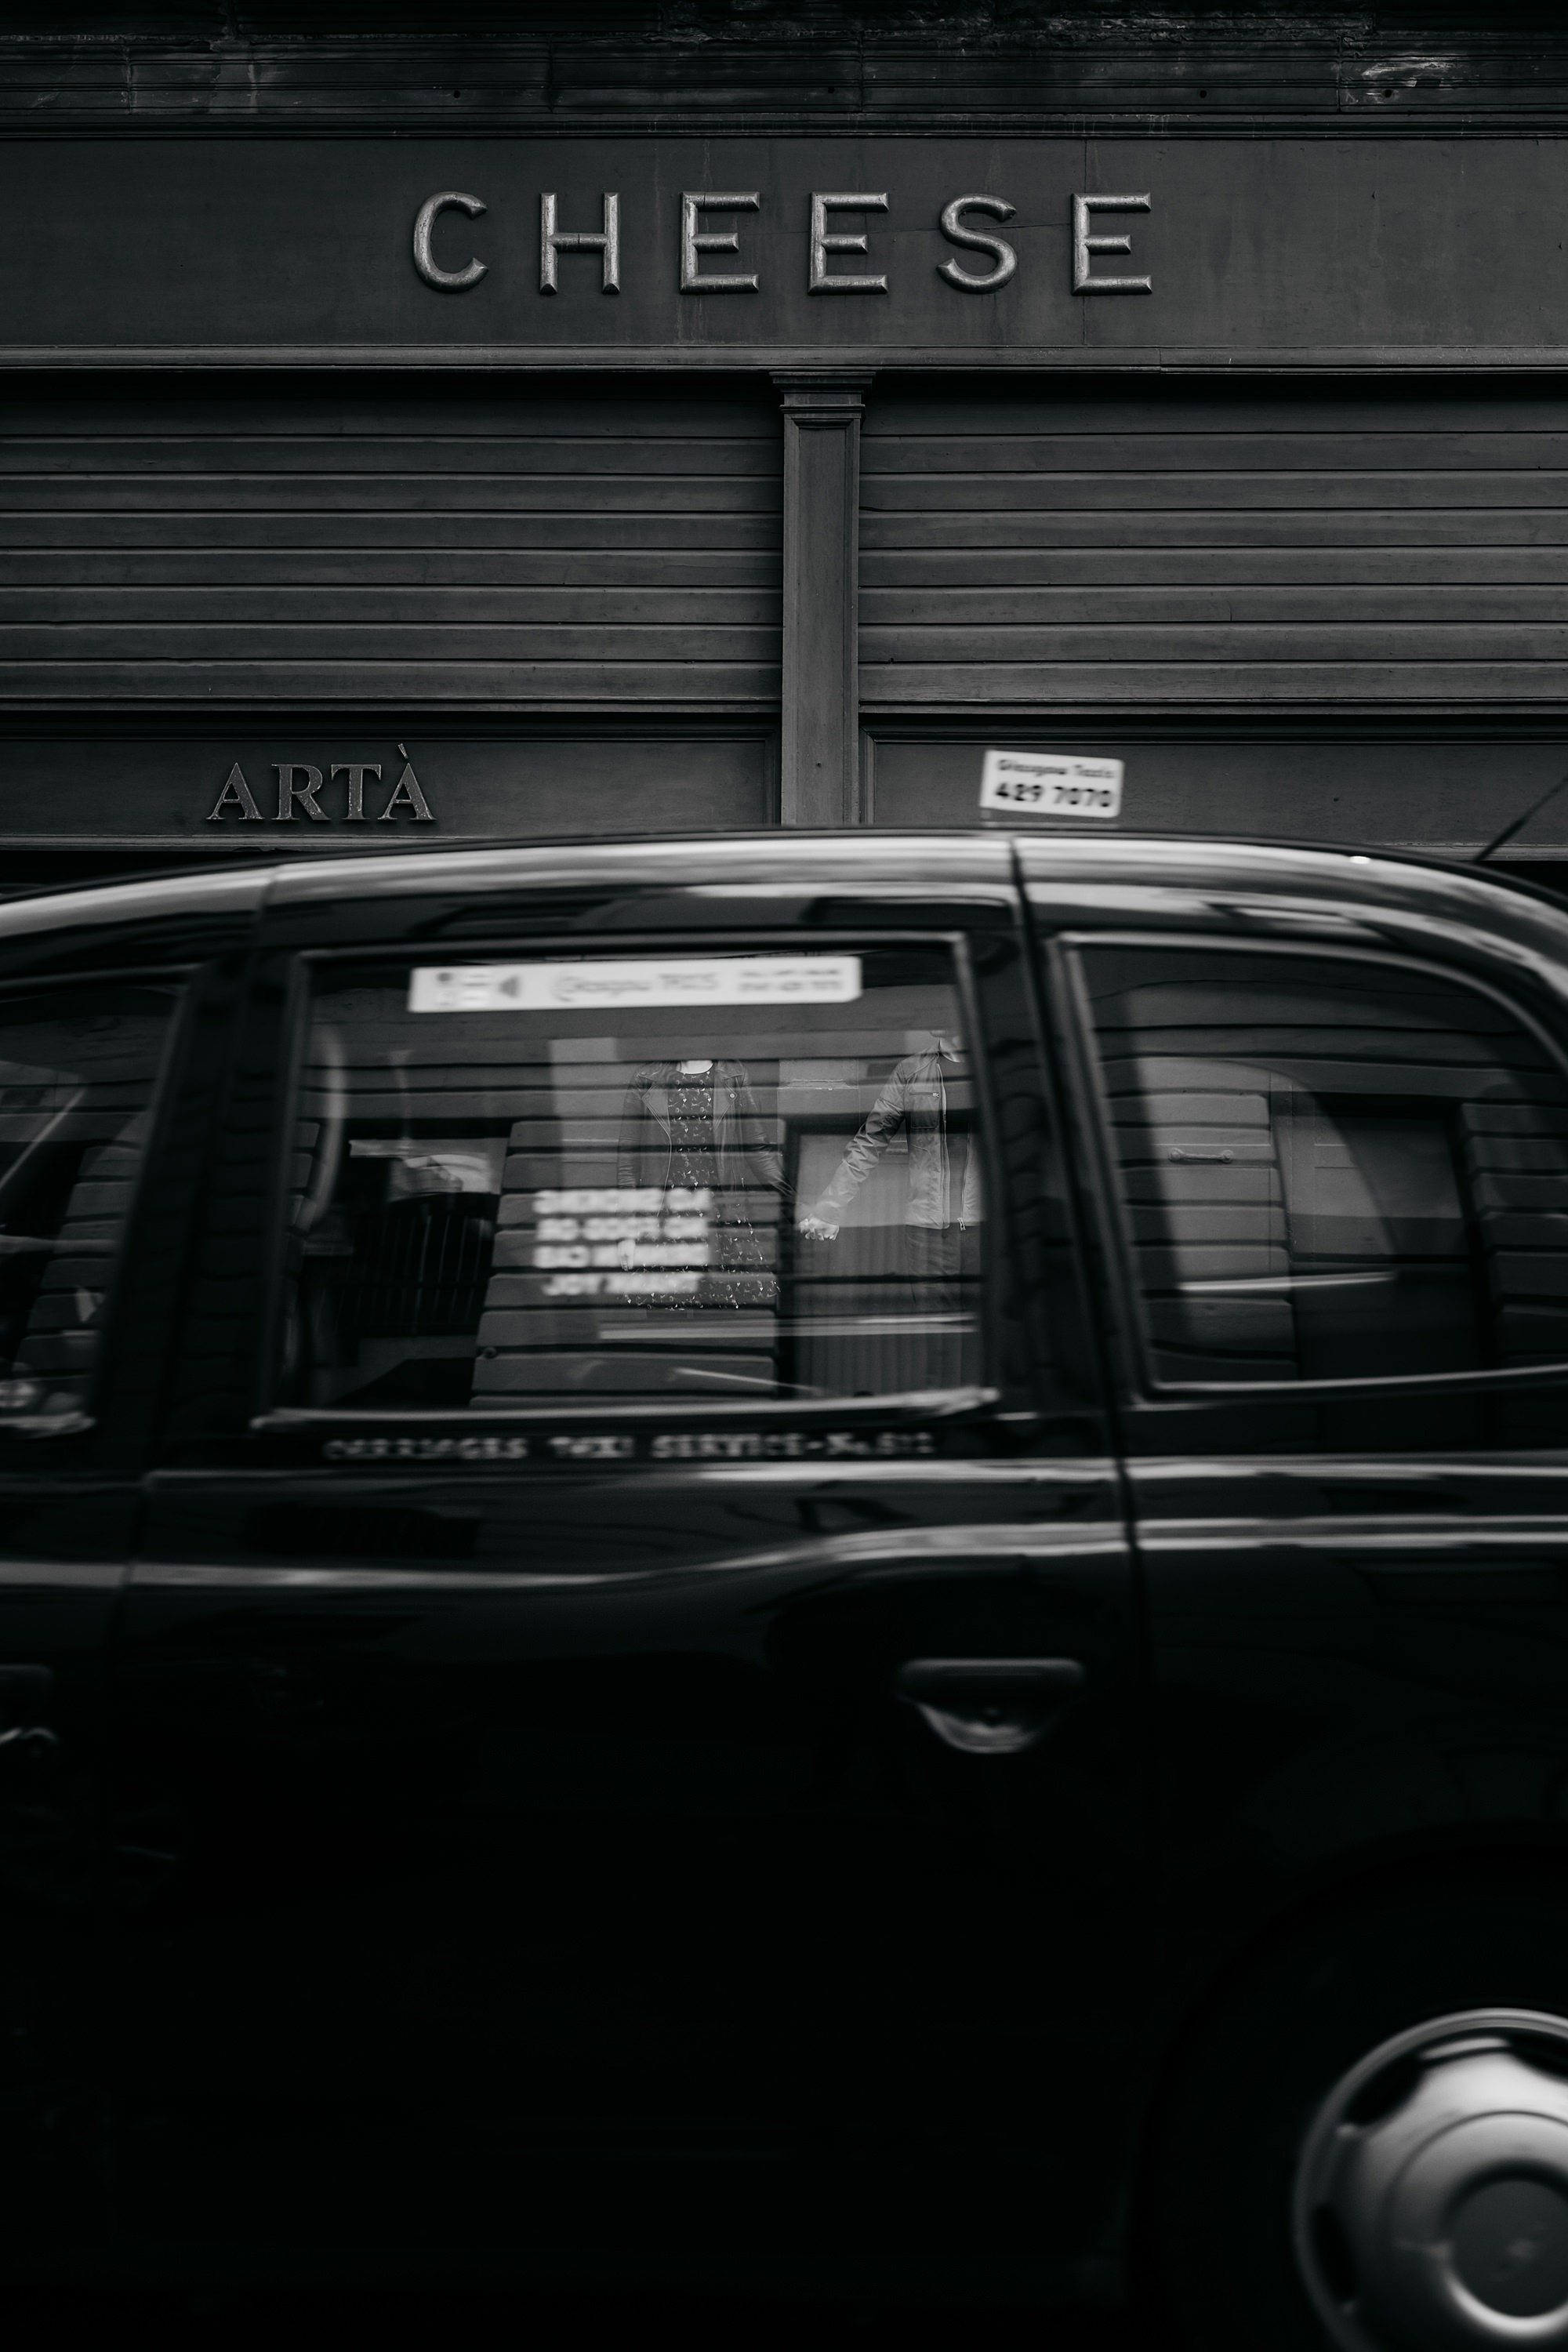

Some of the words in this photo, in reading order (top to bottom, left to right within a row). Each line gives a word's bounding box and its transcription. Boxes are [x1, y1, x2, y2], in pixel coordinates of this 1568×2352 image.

[412, 191, 1154, 294] CHEESE
[205, 742, 437, 822] ARTÀ
[994, 782, 1046, 802] 429
[1052, 785, 1113, 808] 7070
